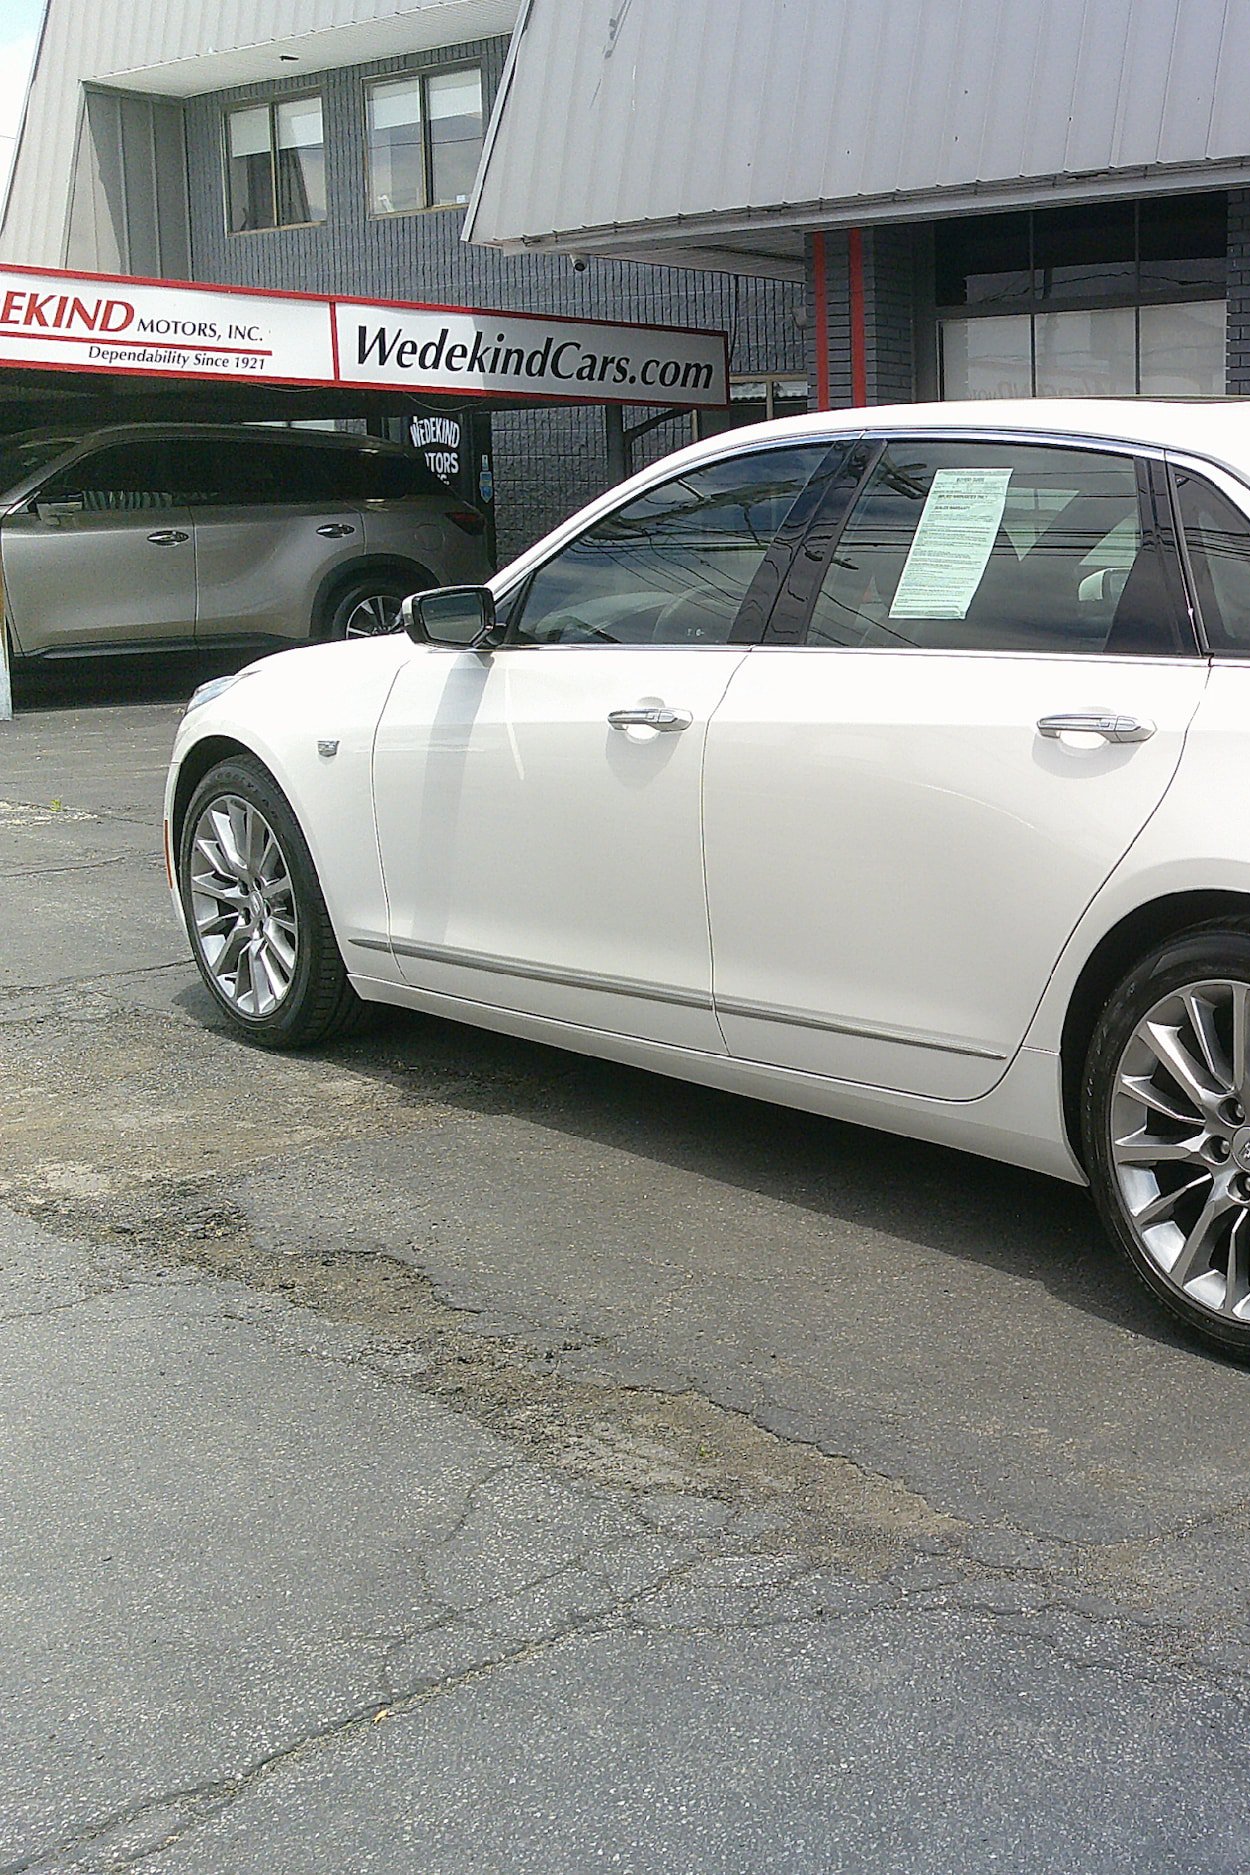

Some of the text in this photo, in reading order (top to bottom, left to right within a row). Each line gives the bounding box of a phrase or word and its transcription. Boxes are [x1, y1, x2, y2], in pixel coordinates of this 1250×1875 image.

[138, 318, 222, 341] MOTORS,
[228, 324, 265, 341] INC.
[88, 345, 267, 370] Dependability Since 1921
[357, 325, 714, 389] WedekindCars.com
[410, 416, 460, 448] WEDEKIND
[424, 452, 459, 473] TORS
